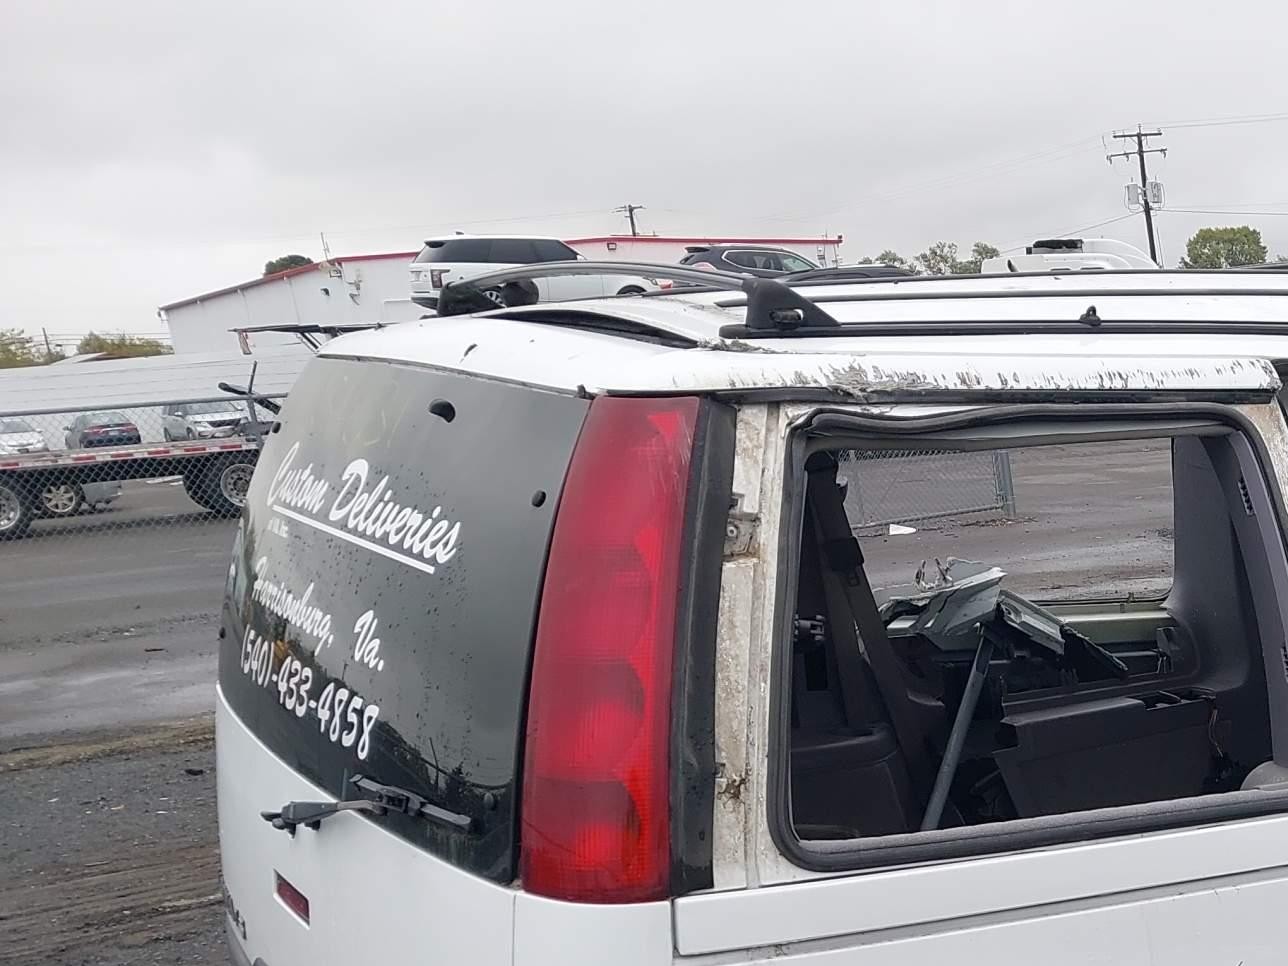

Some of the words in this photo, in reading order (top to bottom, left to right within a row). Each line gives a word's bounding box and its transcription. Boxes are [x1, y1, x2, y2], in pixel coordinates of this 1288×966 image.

[267, 441, 328, 514] Custom
[328, 458, 461, 564] Deliveries
[252, 556, 335, 656] Harrisonburg,
[353, 609, 386, 672] Va.
